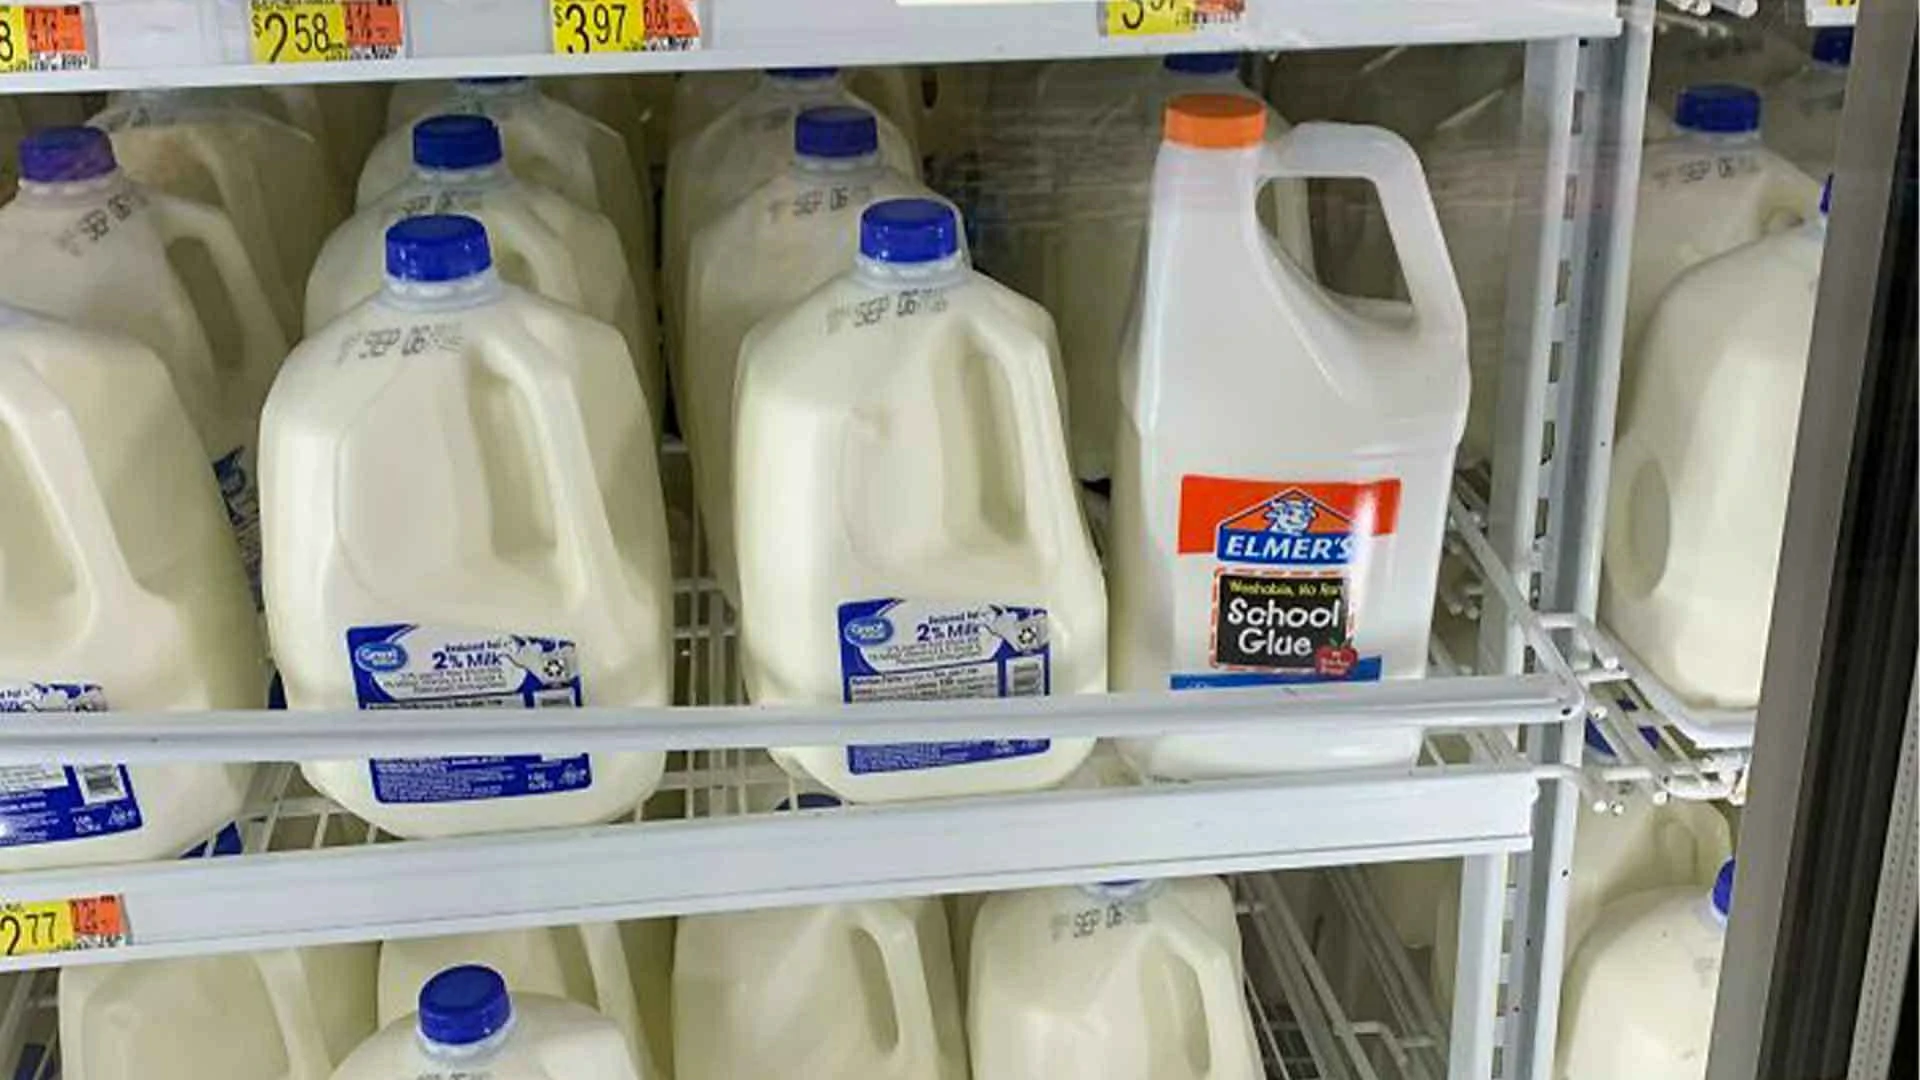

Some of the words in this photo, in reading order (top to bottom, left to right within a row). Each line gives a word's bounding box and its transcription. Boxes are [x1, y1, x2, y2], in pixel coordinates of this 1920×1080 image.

[1225, 534, 1355, 561] ELMER'S
[1227, 597, 1342, 629] School
[1238, 627, 1313, 657] Glue
[432, 651, 463, 670] 2%
